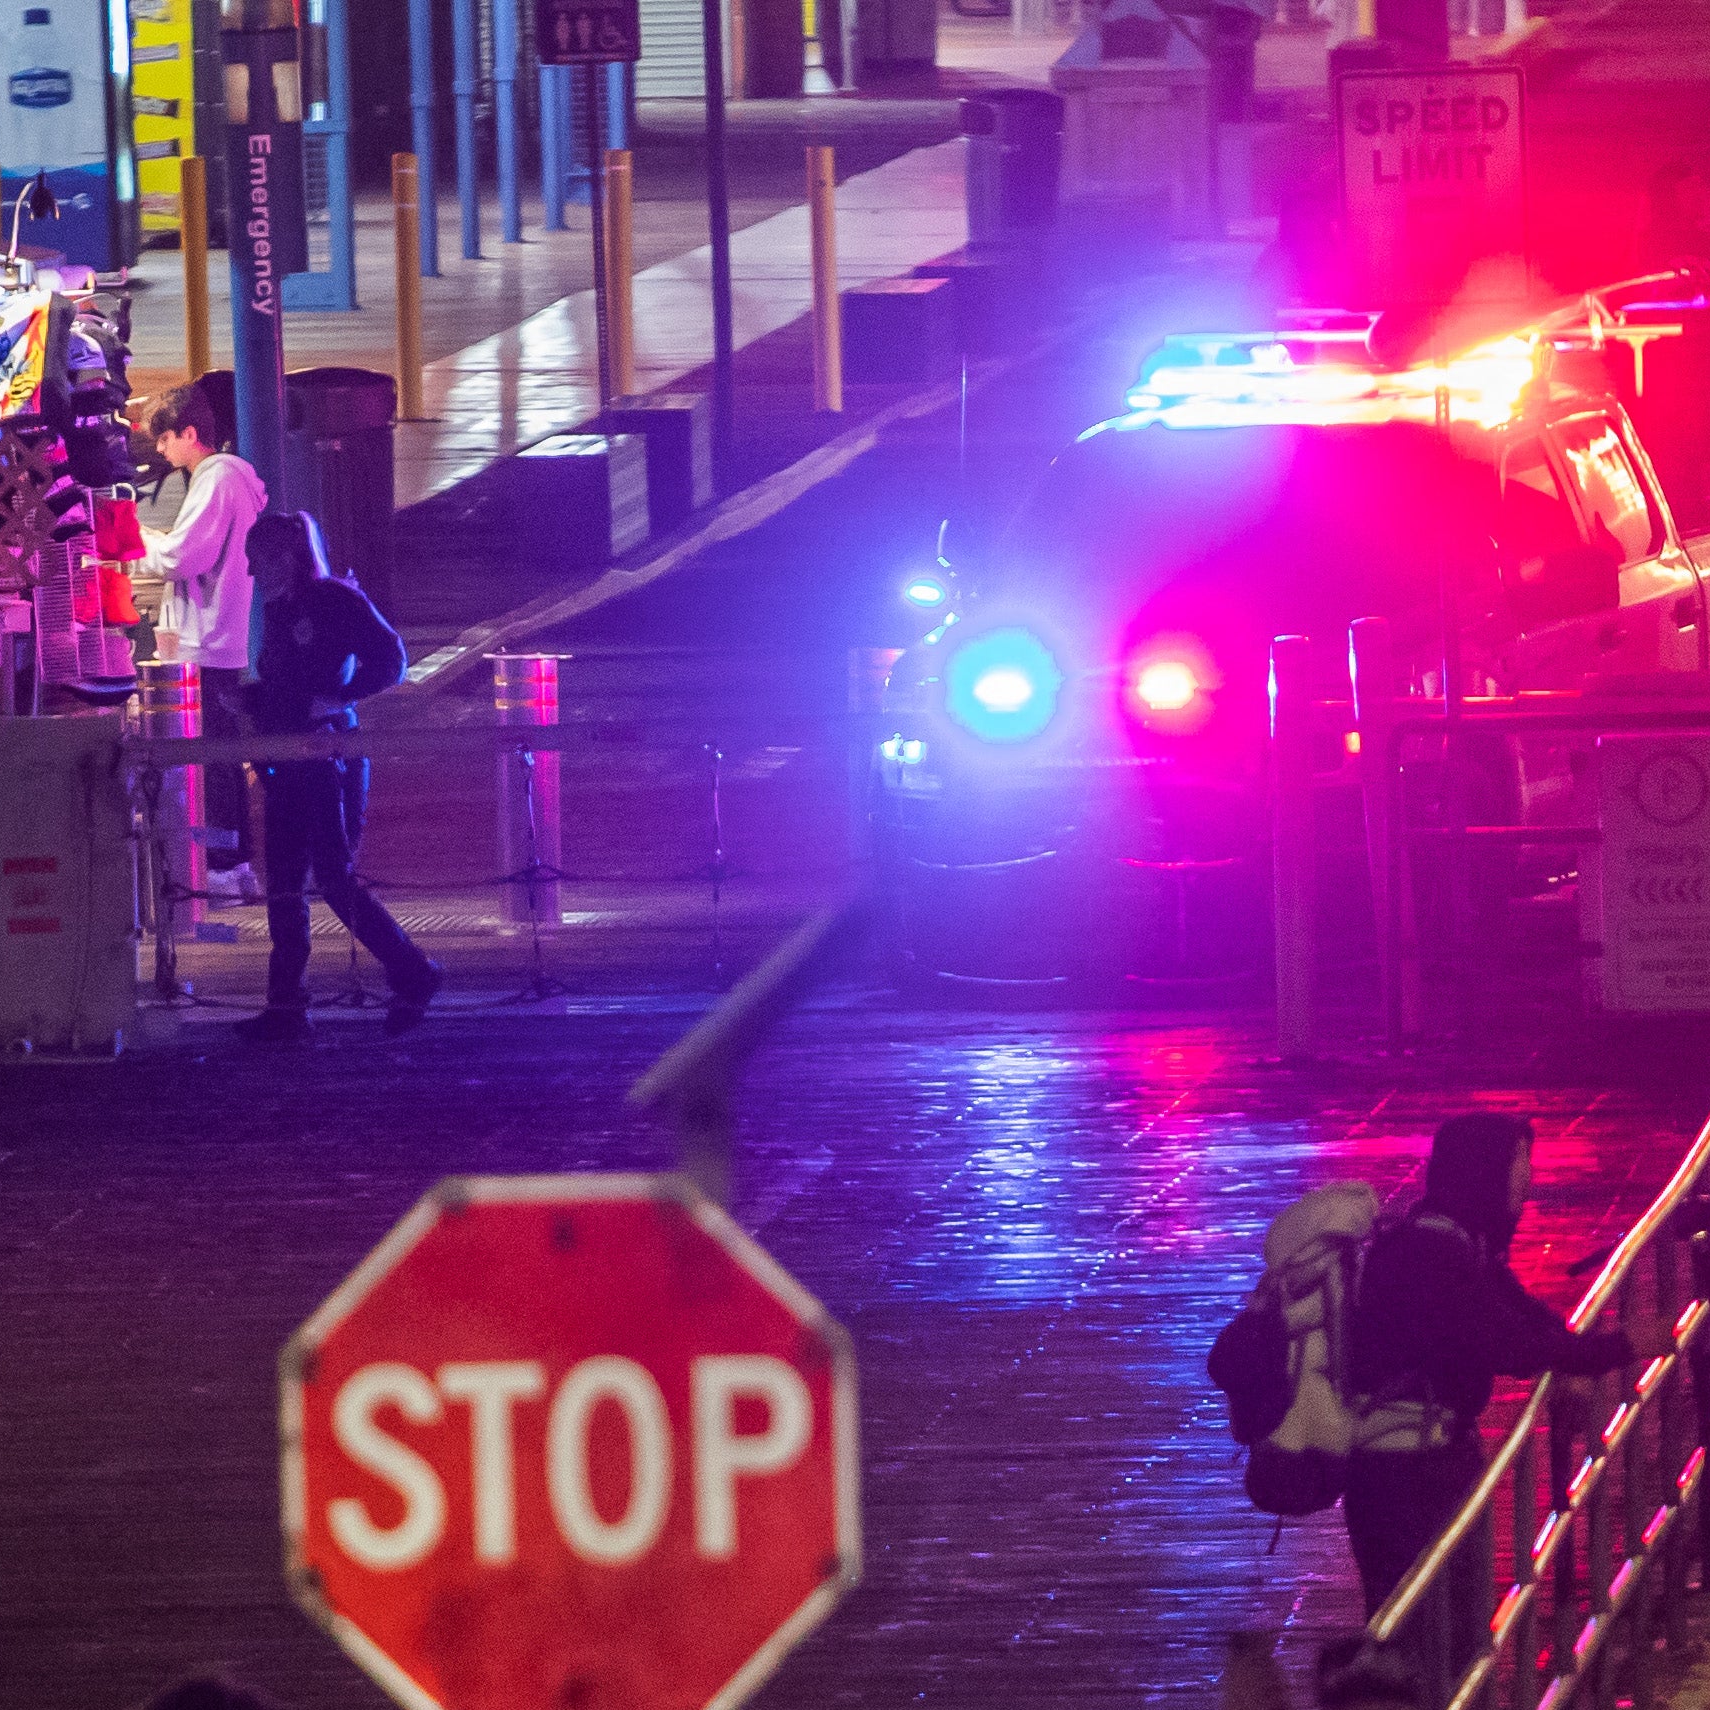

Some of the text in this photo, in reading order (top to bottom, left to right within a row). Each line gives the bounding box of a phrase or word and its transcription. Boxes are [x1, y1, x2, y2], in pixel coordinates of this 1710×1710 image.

[1355, 96, 1509, 135] SPEED
[1373, 143, 1492, 184] LIMIT
[247, 134, 275, 315] Emergency
[328, 1353, 815, 1571] STOP
